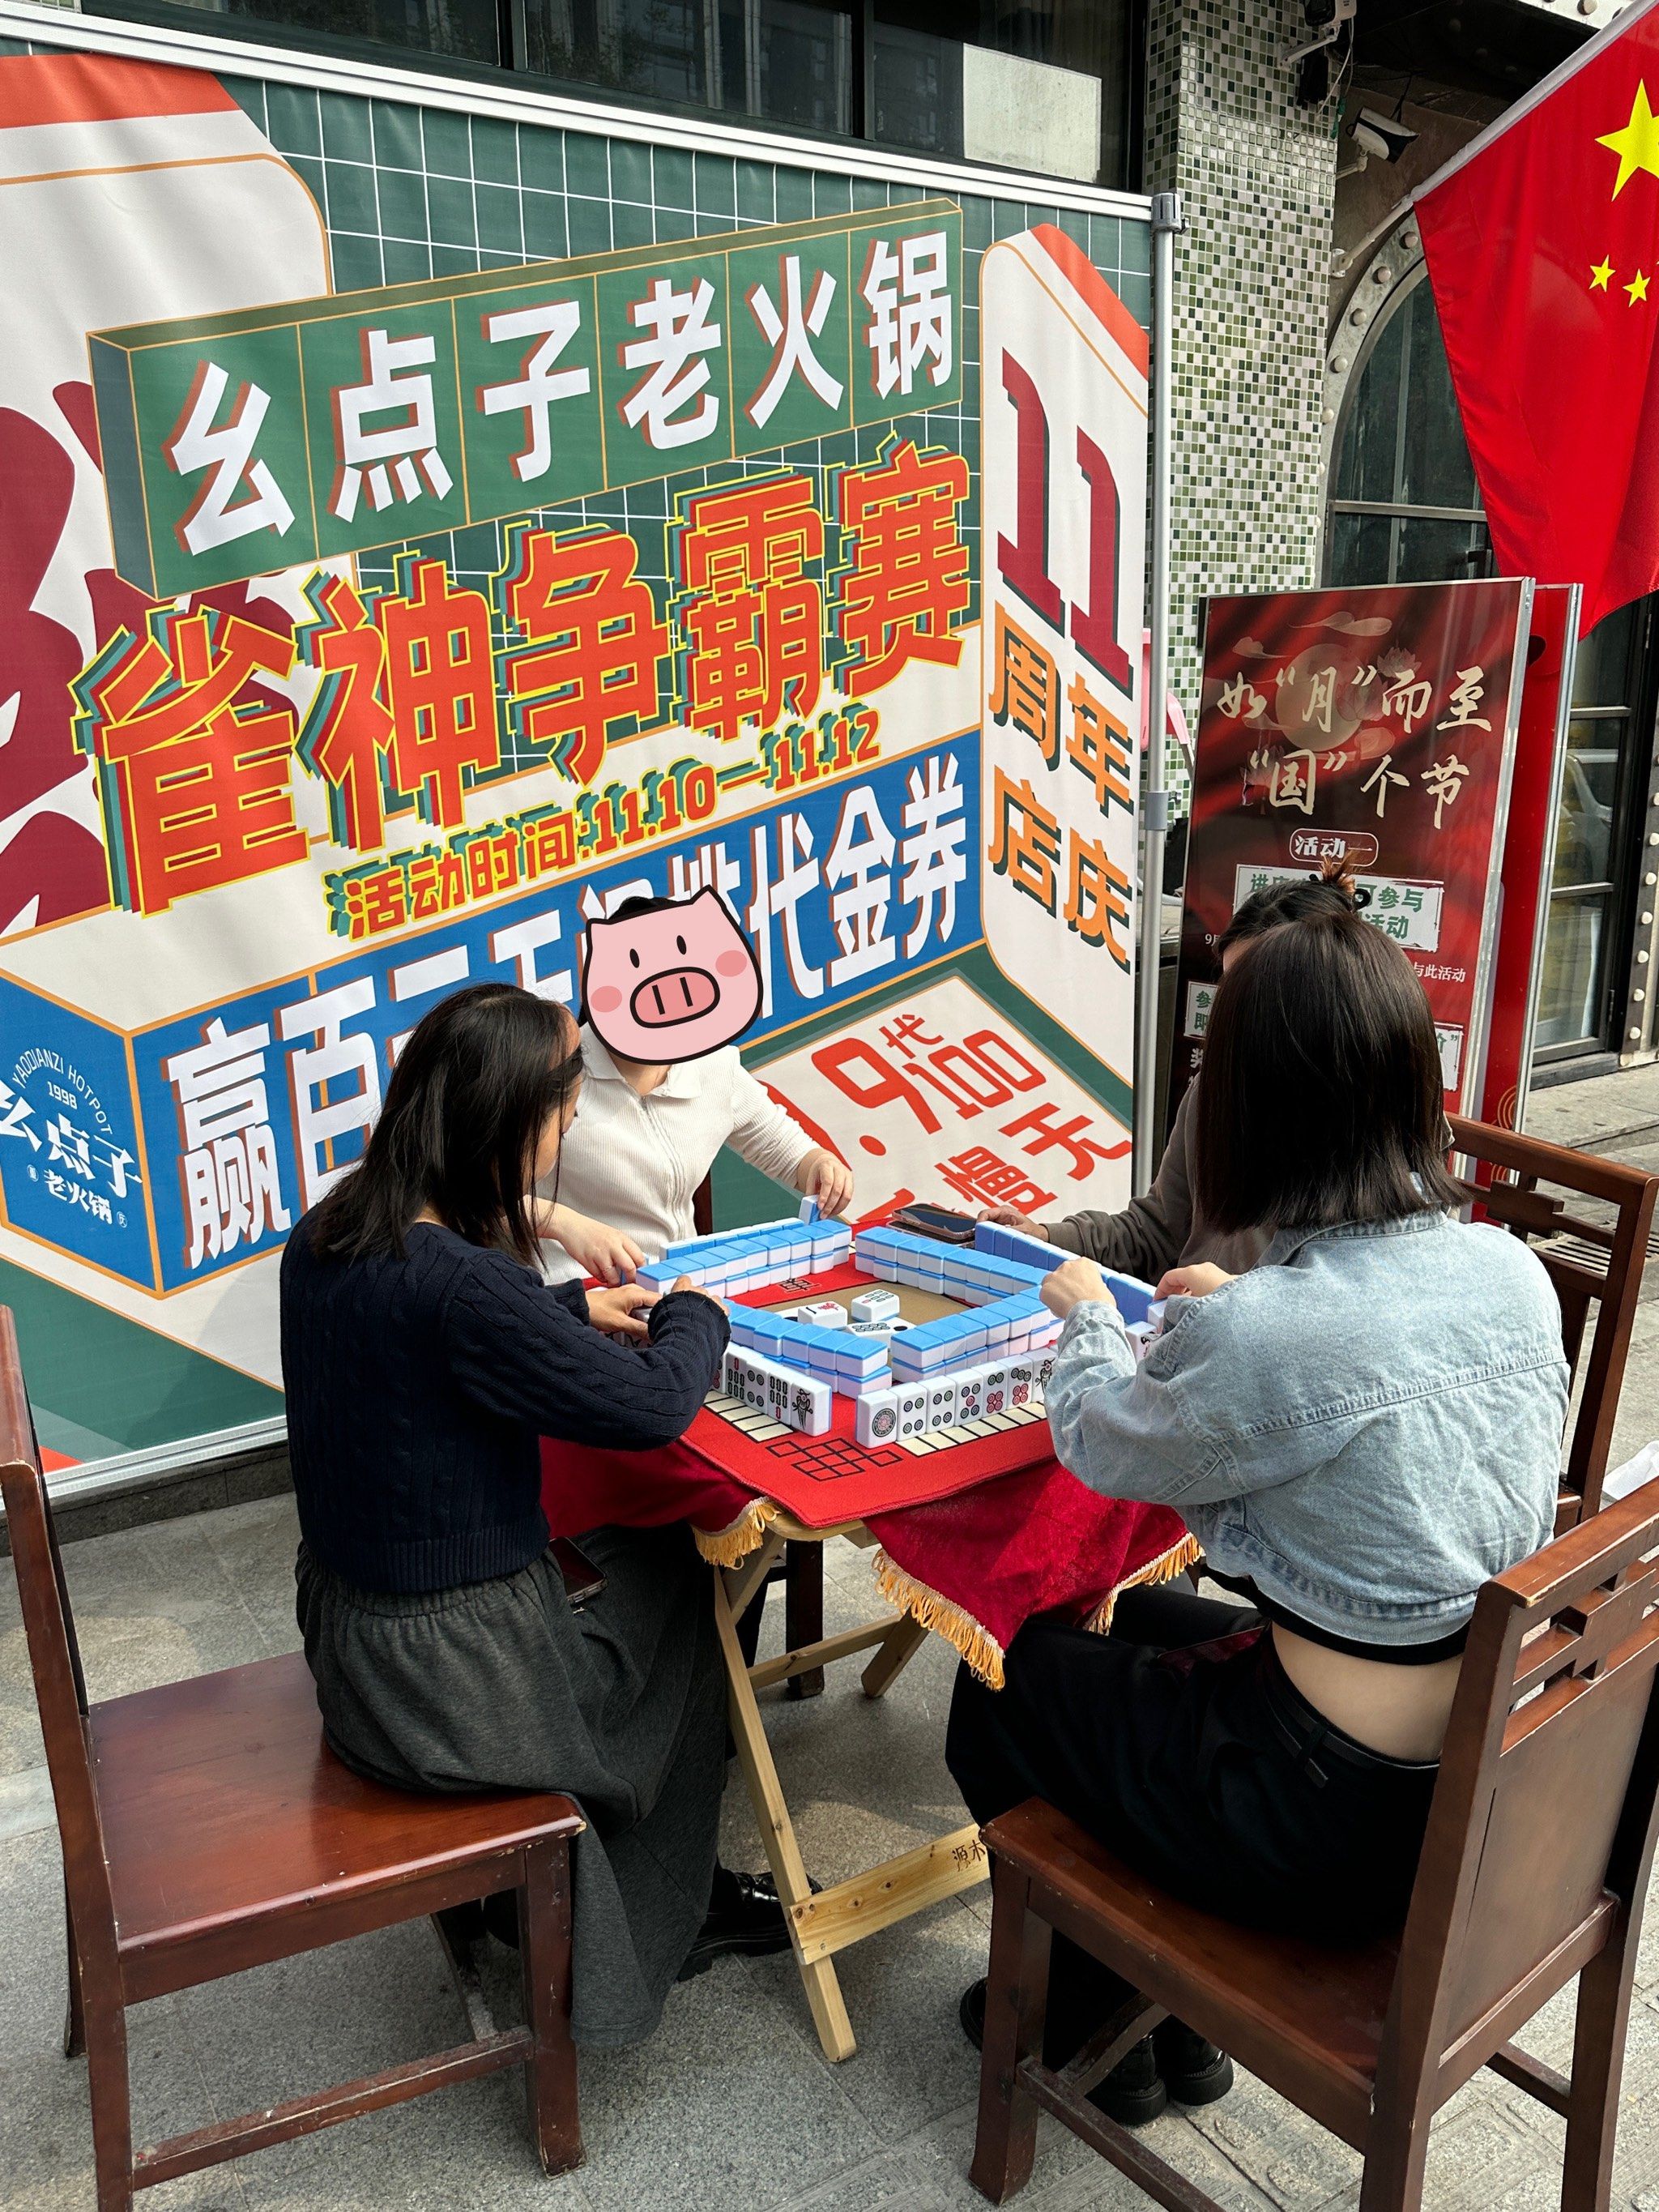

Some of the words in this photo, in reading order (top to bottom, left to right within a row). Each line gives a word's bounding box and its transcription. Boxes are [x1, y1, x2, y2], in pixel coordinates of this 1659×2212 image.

[997, 347, 1133, 698] 11
[67, 431, 970, 919] 雀神争霸赛
[988, 600, 1134, 818] 周年
[988, 765, 1132, 972] 店庆
[162, 753, 967, 1270] 赢百代金券
[879, 1014, 945, 1060] 代
[902, 1029, 1047, 1121] 100
[47, 1081, 78, 1110] 1998
[67, 1065, 113, 1135] HOTPOT
[43, 1168, 113, 1225] 老火锅
